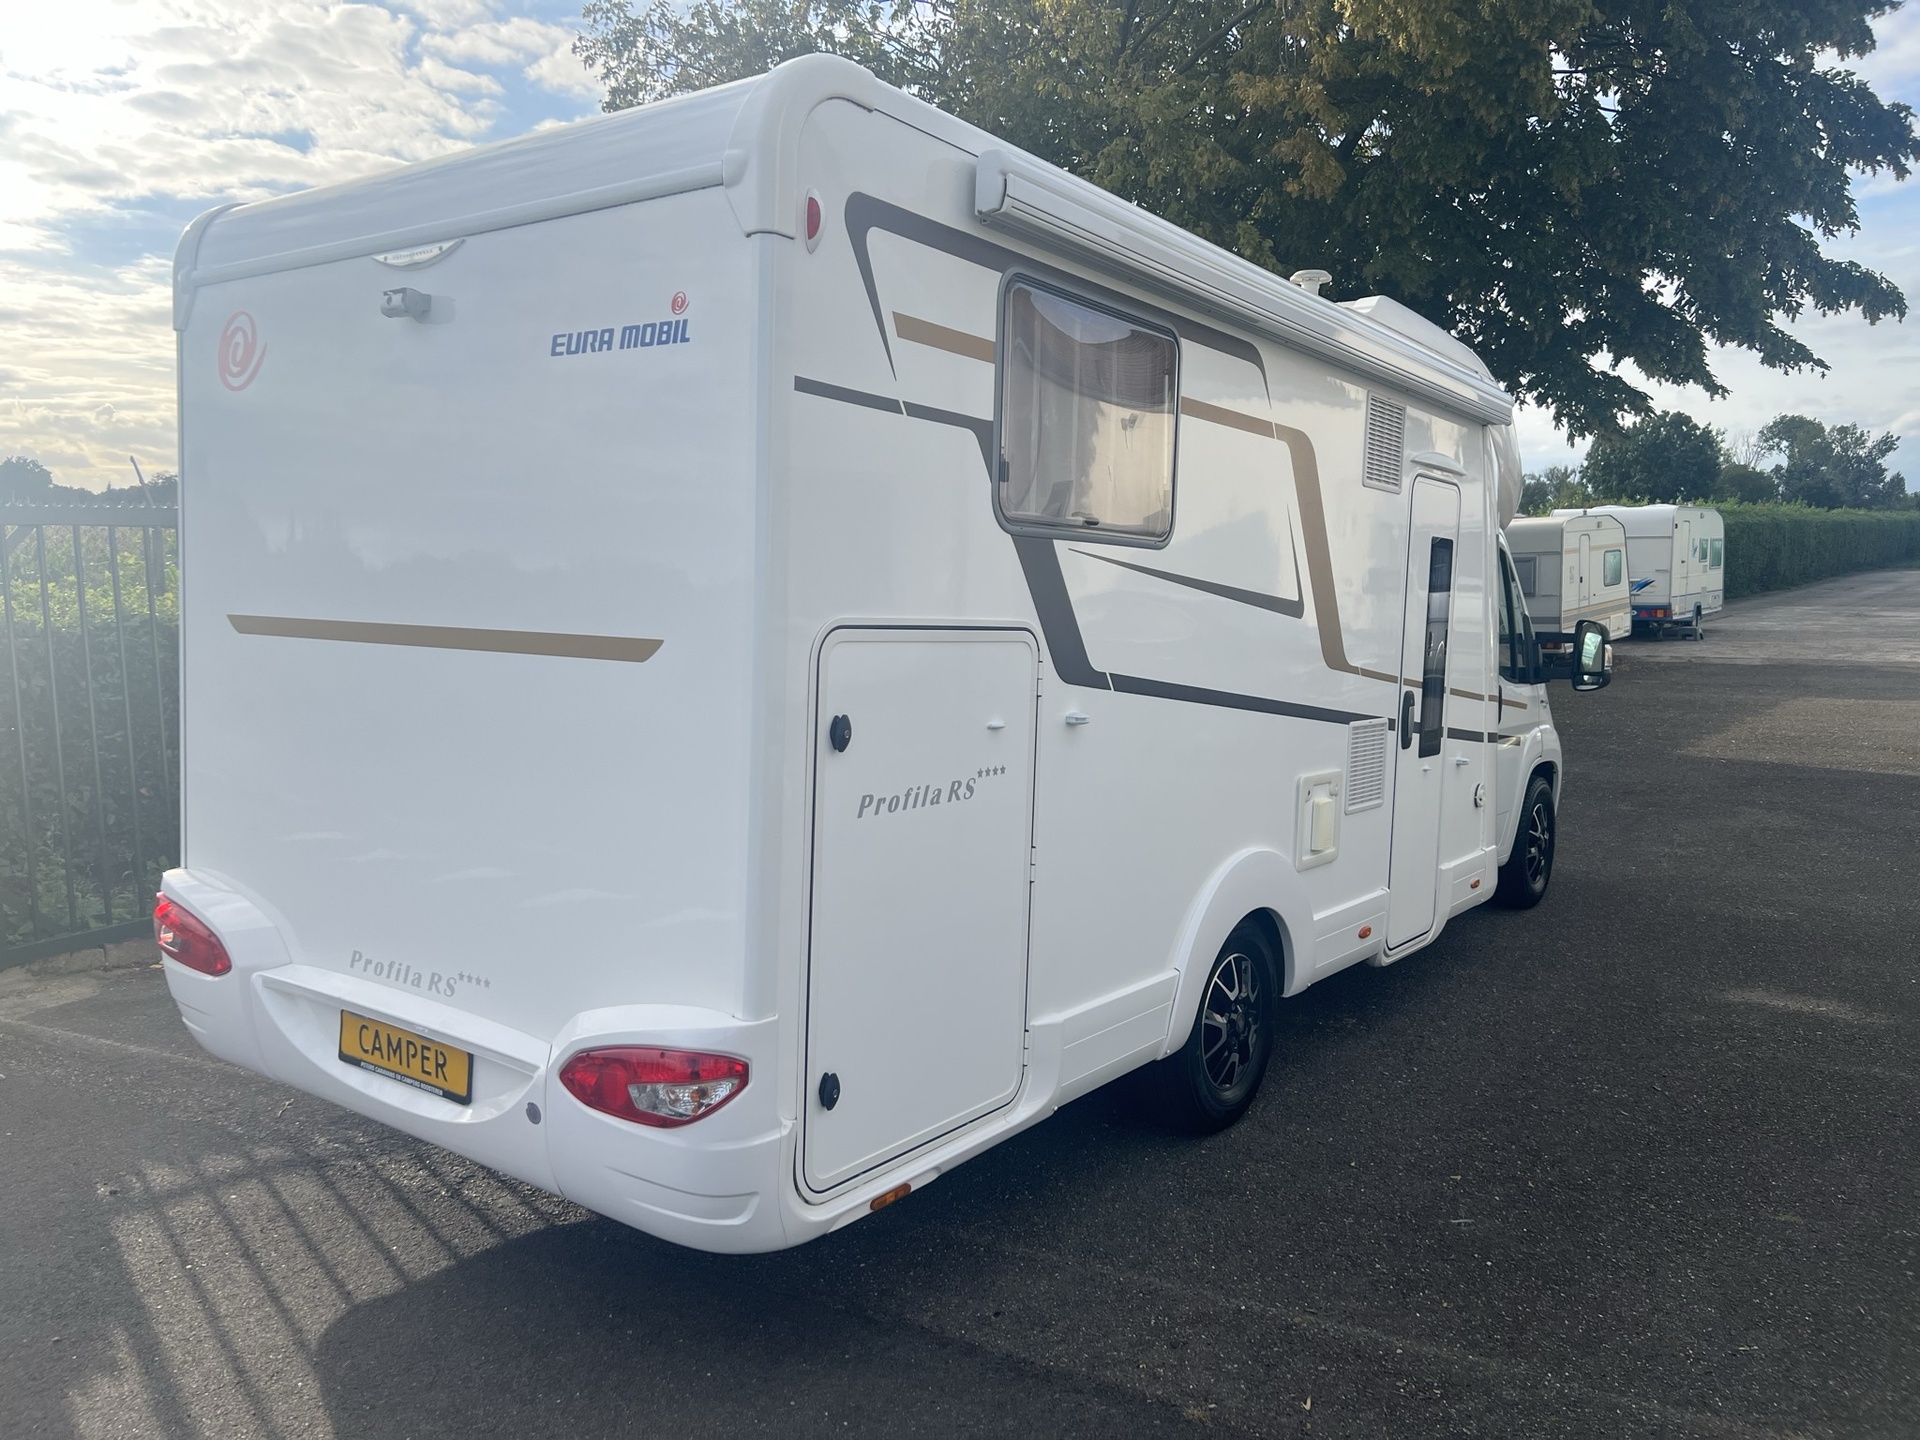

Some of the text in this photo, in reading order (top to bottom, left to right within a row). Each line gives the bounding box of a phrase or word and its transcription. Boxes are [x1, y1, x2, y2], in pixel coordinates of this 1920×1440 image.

[551, 319, 690, 356] EURA MOBIL
[857, 784, 942, 818] Profila
[350, 950, 422, 988] Profila
[359, 1024, 447, 1082] CAMPER
[401, 1075, 420, 1088] CAMPERS
